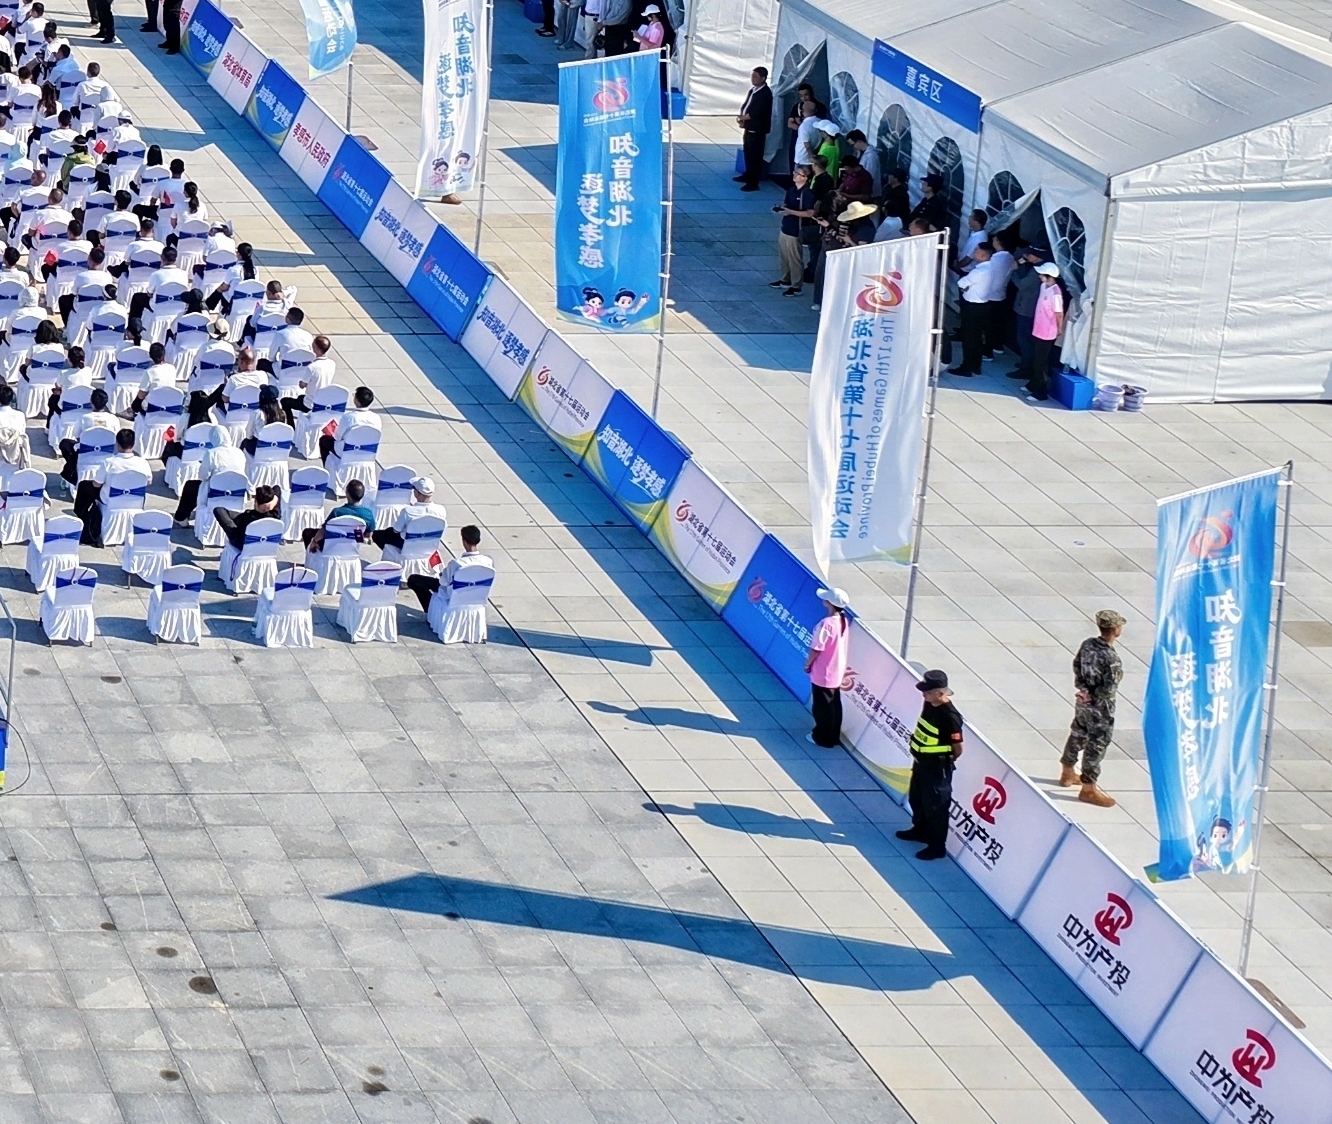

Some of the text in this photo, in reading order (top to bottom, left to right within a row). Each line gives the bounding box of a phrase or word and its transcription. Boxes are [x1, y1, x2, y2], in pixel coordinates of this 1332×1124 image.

[905, 65, 943, 104] 嘉宾区
[292, 122, 332, 169] 孝感市人民政府
[476, 304, 531, 369] 知音湖北 逐梦孝感
[597, 424, 667, 502] 知音湖北 逐梦孝感
[688, 512, 737, 567] 湖北省第十七届运动会
[762, 590, 813, 647] 湖北省第十七届运
[854, 682, 911, 744] 湖北省第十七届运动
[949, 798, 1004, 866] 中为产投
[1062, 913, 1131, 990] 中为产投
[1195, 1049, 1275, 1124] 中为产投
